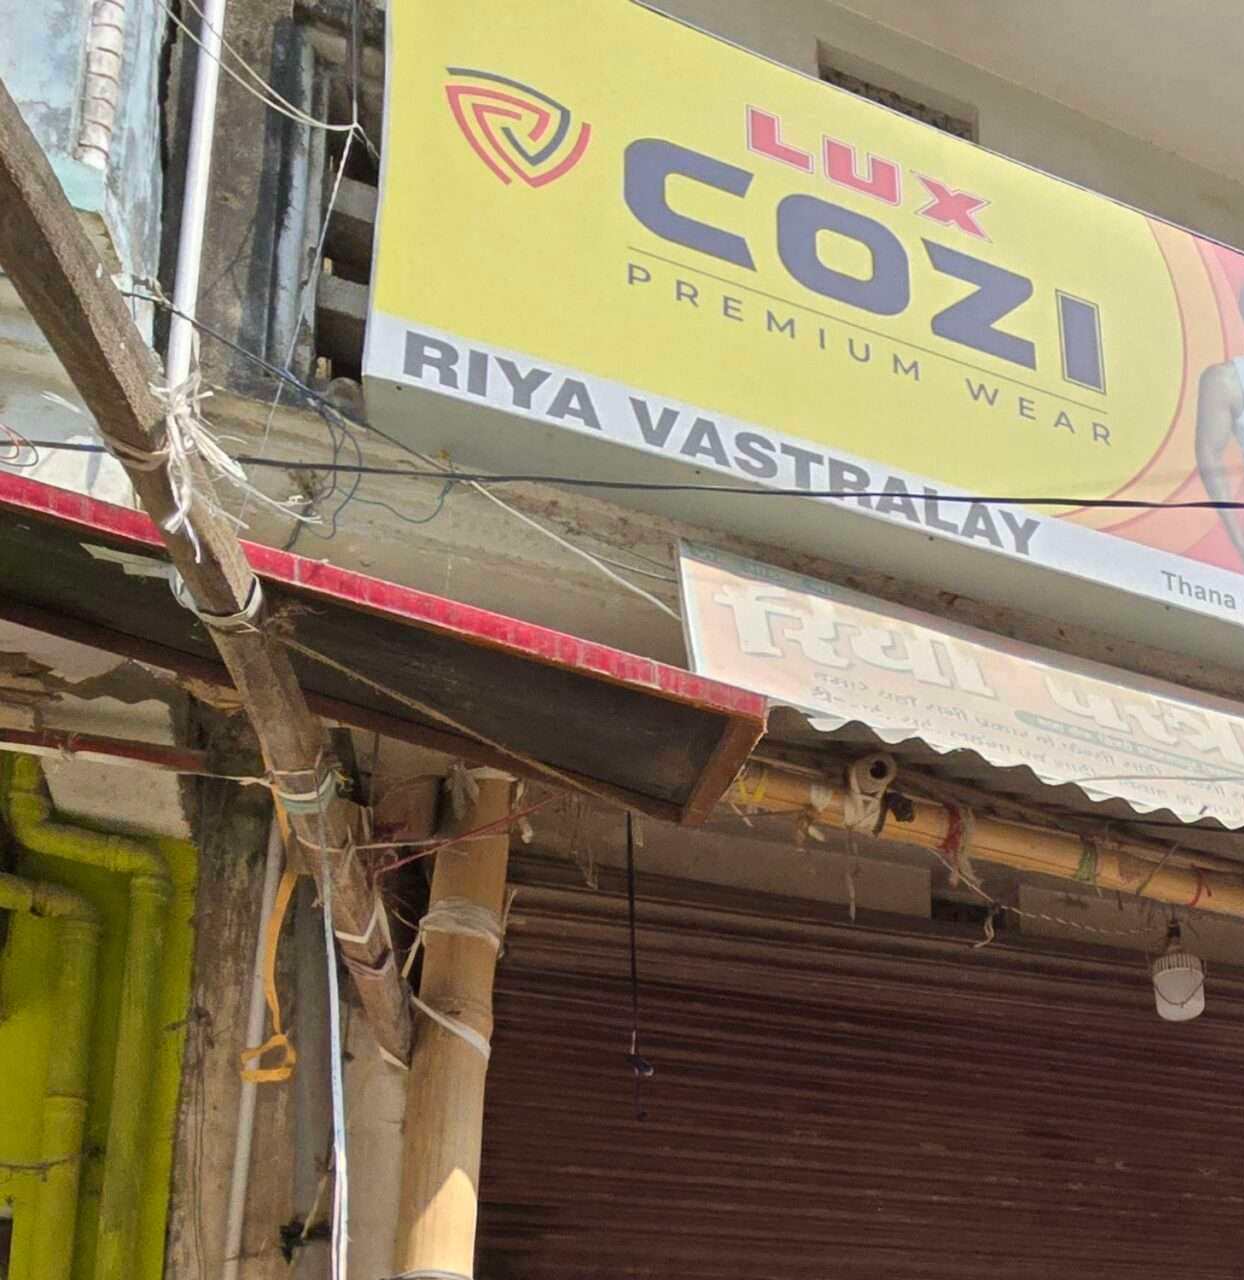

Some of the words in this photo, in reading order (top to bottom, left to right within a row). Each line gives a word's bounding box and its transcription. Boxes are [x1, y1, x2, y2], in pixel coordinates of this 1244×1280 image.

[747, 105, 991, 242] LUX
[624, 138, 1106, 395] COZI
[627, 263, 920, 382] PREMIUM
[966, 378, 1110, 446] WEAR
[402, 331, 601, 429] RIYA
[631, 397, 1040, 555] VASTRALAY
[1161, 570, 1237, 610] Thana
